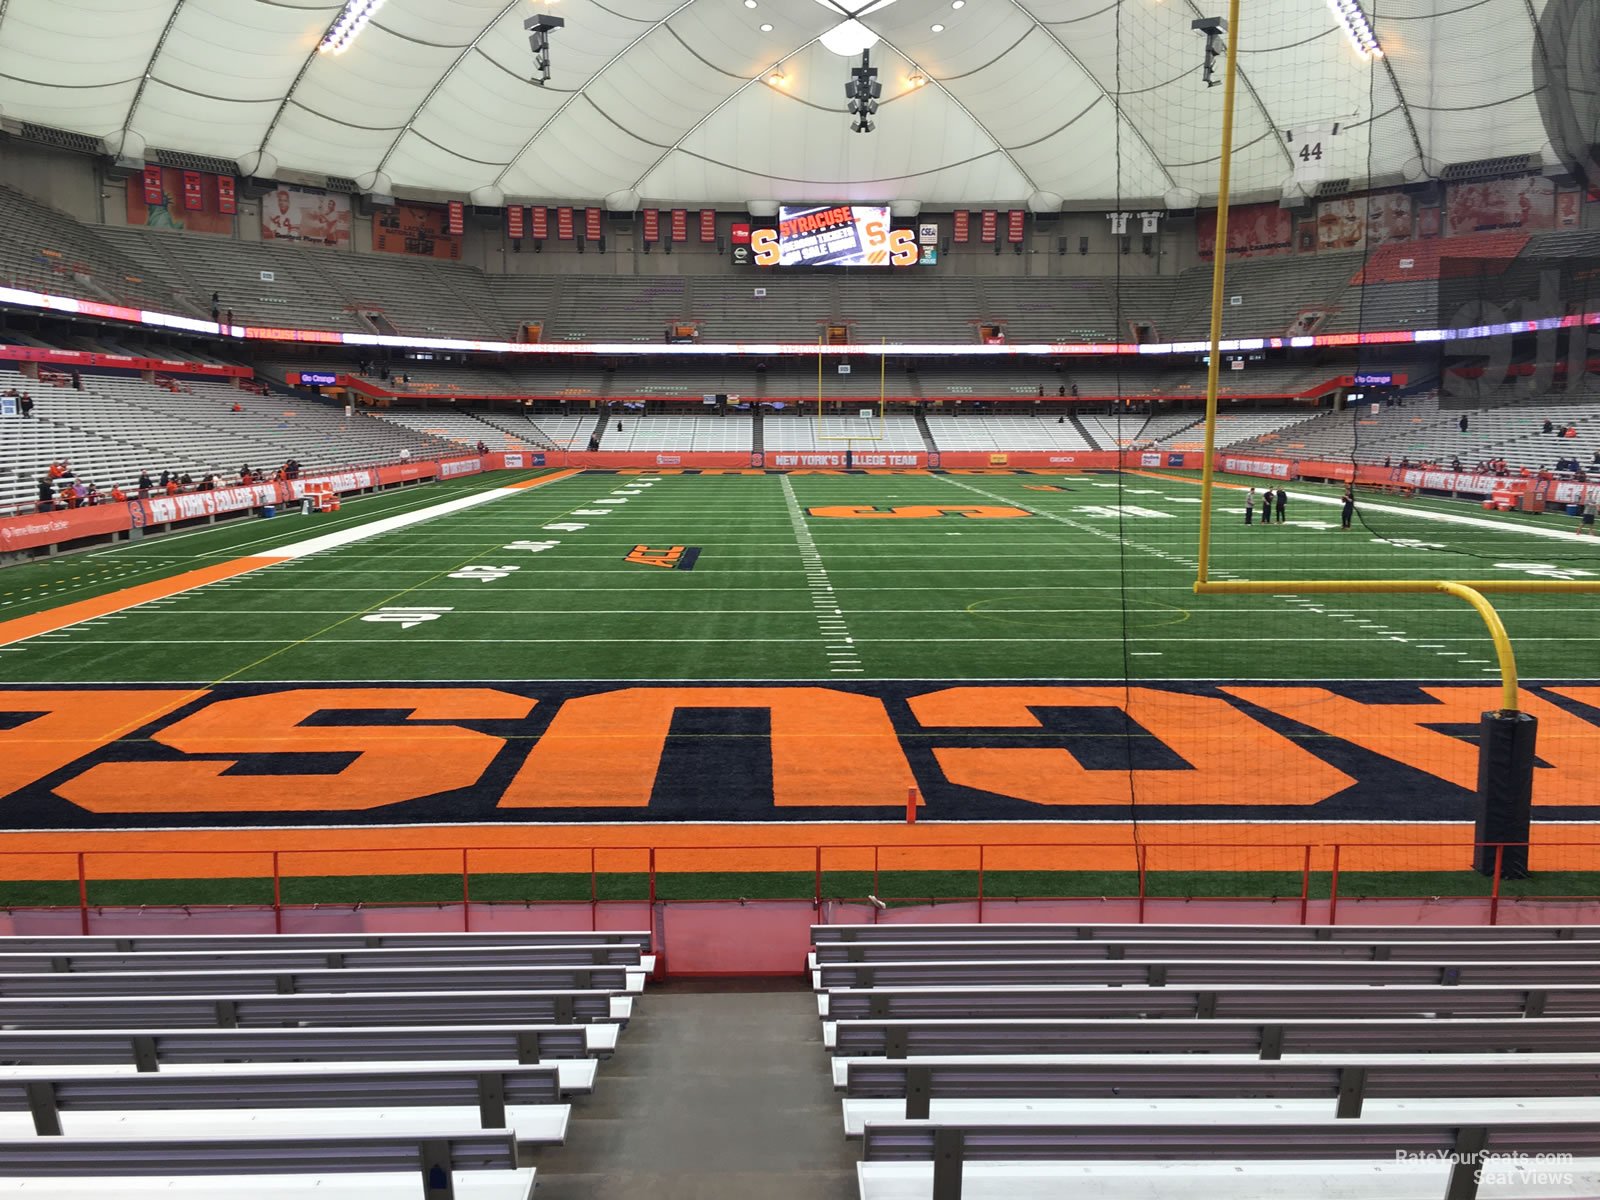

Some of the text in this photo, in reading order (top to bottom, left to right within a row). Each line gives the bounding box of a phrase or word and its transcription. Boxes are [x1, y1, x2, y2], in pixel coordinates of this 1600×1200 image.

[1299, 142, 1322, 162] 44
[780, 206, 852, 237] SYRACUSE
[784, 221, 853, 241] FOOTBALL
[866, 221, 885, 247] S
[752, 228, 780, 266] S
[889, 229, 918, 266] S
[246, 327, 296, 341] SYRACUSE
[301, 374, 336, 384] Go Orange
[776, 455, 798, 466] NEW
[801, 455, 839, 466] YORK'S
[889, 455, 917, 466] TEAM
[149, 498, 176, 523] NEW
[177, 493, 215, 518] YORK'S
[215, 487, 254, 511] COLLEGE
